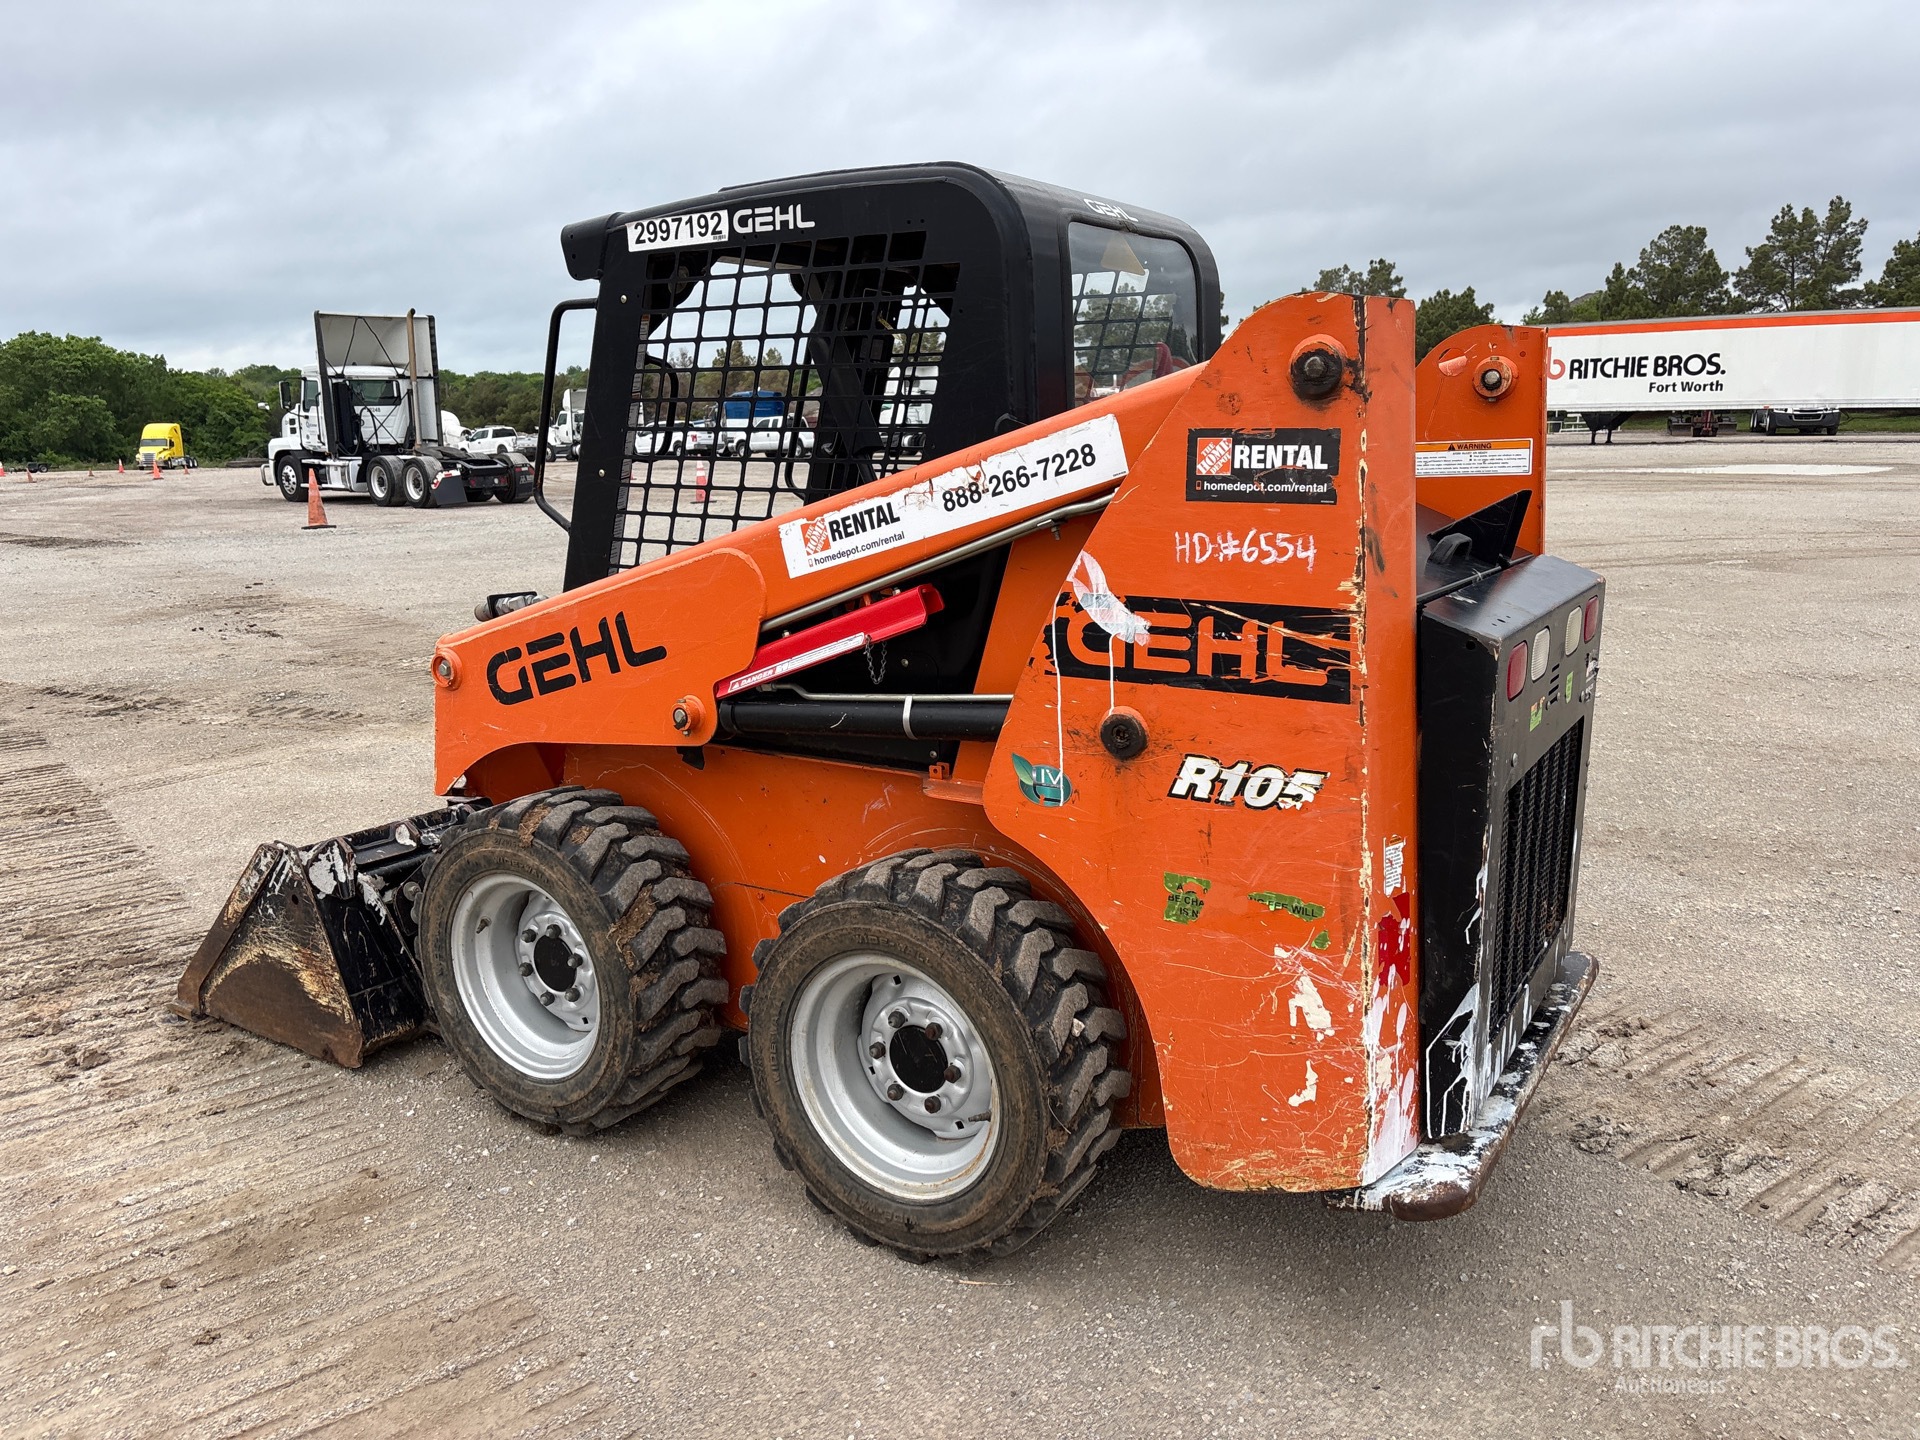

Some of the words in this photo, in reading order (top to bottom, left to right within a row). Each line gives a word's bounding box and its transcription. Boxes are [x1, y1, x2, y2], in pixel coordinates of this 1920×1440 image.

[732, 203, 816, 234] GEHL
[1083, 198, 1139, 222] GEHL
[633, 212, 723, 245] 2997192
[1569, 355, 1649, 380] RITCHIE
[1653, 352, 1726, 377] BROS.
[1649, 382, 1677, 393] Fort
[1681, 380, 1724, 392] Worth
[1197, 438, 1231, 475] HOME
[1201, 441, 1215, 457] THE
[1233, 444, 1328, 470] RENTAL
[1456, 442, 1492, 450] WARNING
[942, 443, 1096, 512] 888-266-7228
[1210, 451, 1231, 475] DEPOT
[1203, 481, 1327, 494] homedepot.com/rental
[828, 501, 900, 542] RENTAL
[805, 519, 826, 555] HOME
[814, 531, 905, 566] homedepot.com/rental
[486, 610, 668, 706] GEHL
[1067, 608, 1328, 687] GEHL
[740, 669, 773, 685] DANGER
[1170, 755, 1328, 810] R105
[1291, 904, 1318, 918] WILL
